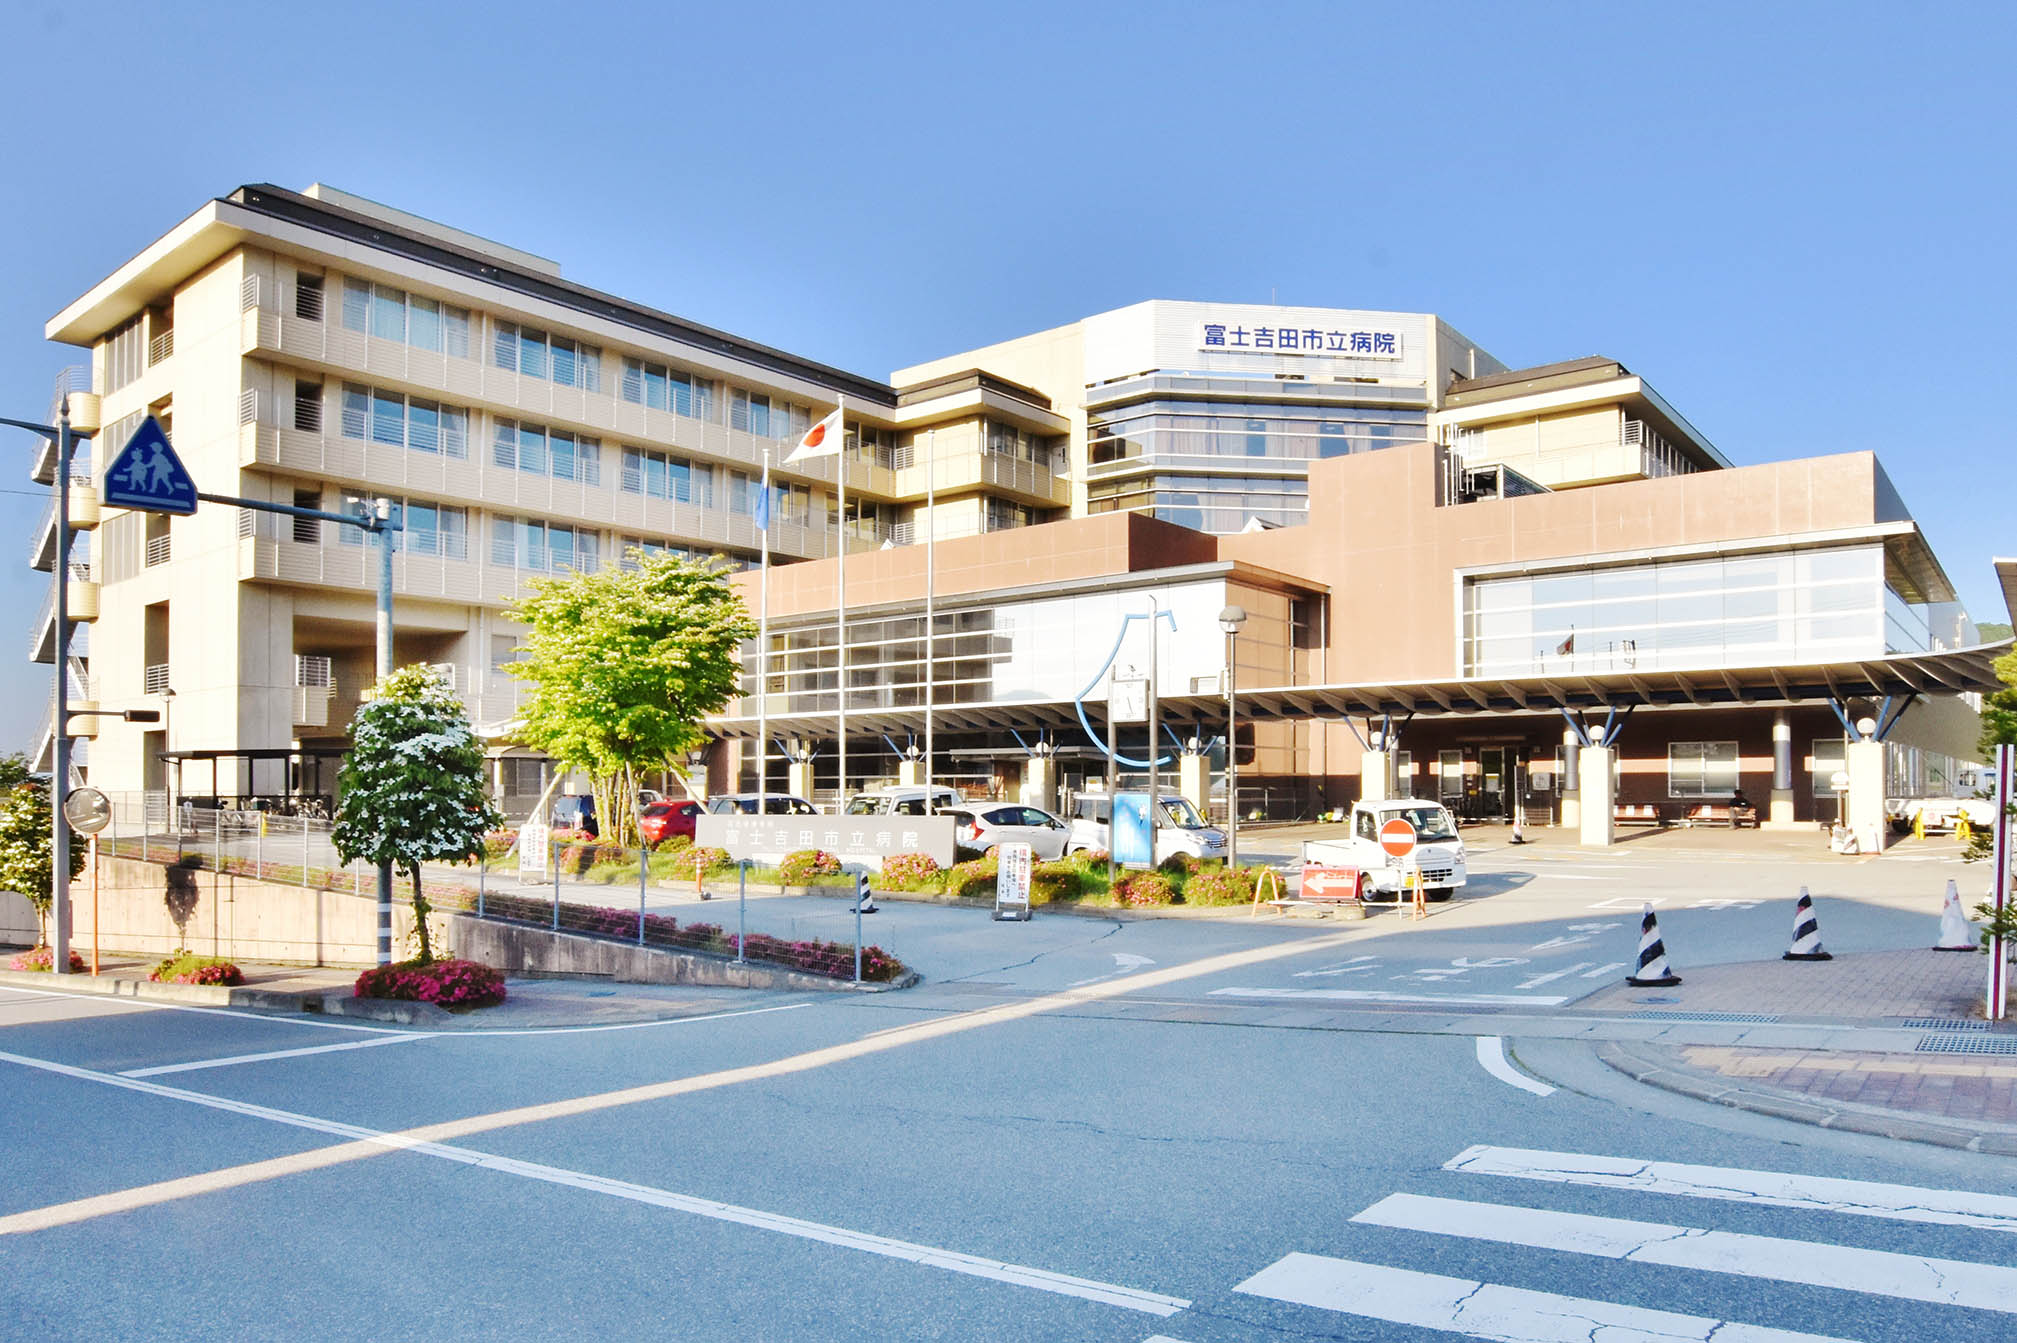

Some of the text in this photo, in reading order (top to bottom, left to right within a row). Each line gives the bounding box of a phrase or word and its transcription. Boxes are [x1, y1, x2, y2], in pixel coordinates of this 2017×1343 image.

[1204, 323, 1396, 354] 富士吉田市立病院
[725, 829, 919, 848] 富士吉田市立病院
